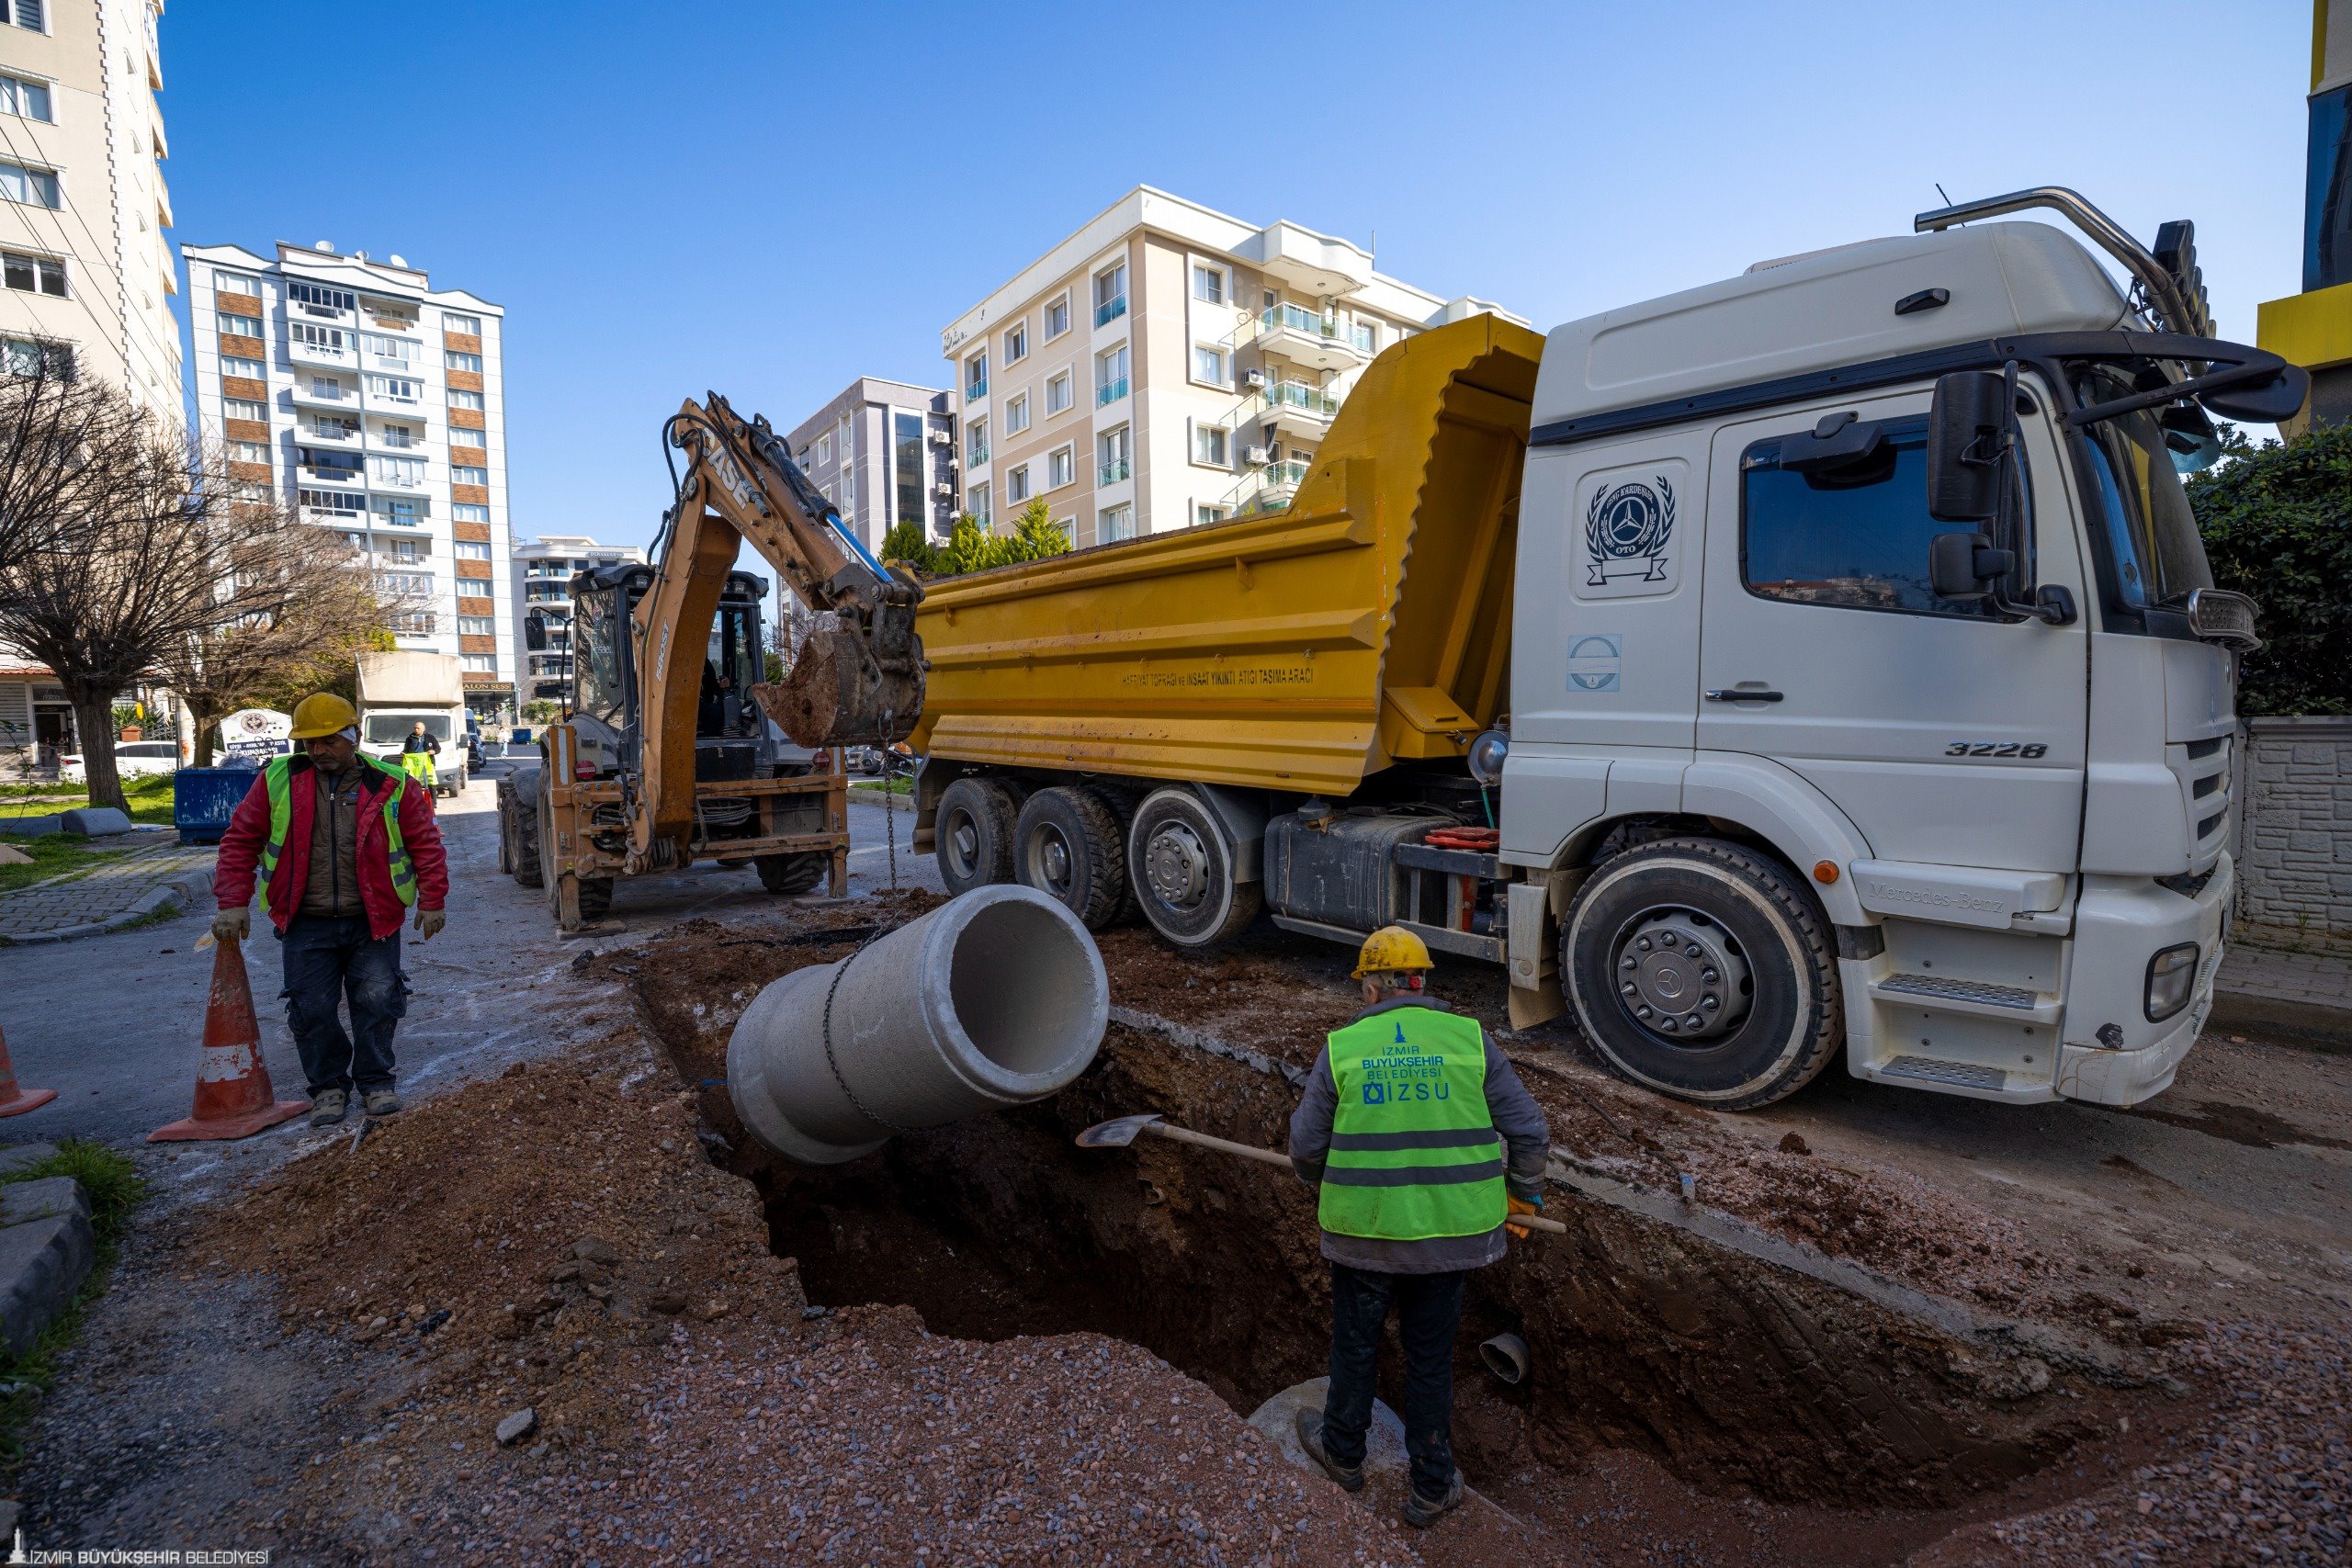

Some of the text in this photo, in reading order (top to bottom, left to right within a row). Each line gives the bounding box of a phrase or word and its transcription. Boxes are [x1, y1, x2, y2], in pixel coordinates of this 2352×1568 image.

[702, 427, 750, 511] CASE
[1616, 545, 1636, 554] OTO
[1288, 667, 1314, 683] ARACI
[1945, 740, 2049, 759] 3228
[1868, 882, 2004, 913] Mercedes-Benz
[1363, 1055, 1443, 1069] BÜYÜKŞEHİR
[1367, 1067, 1442, 1079] BELEDİYESİ
[1387, 1081, 1449, 1101] İZSU
